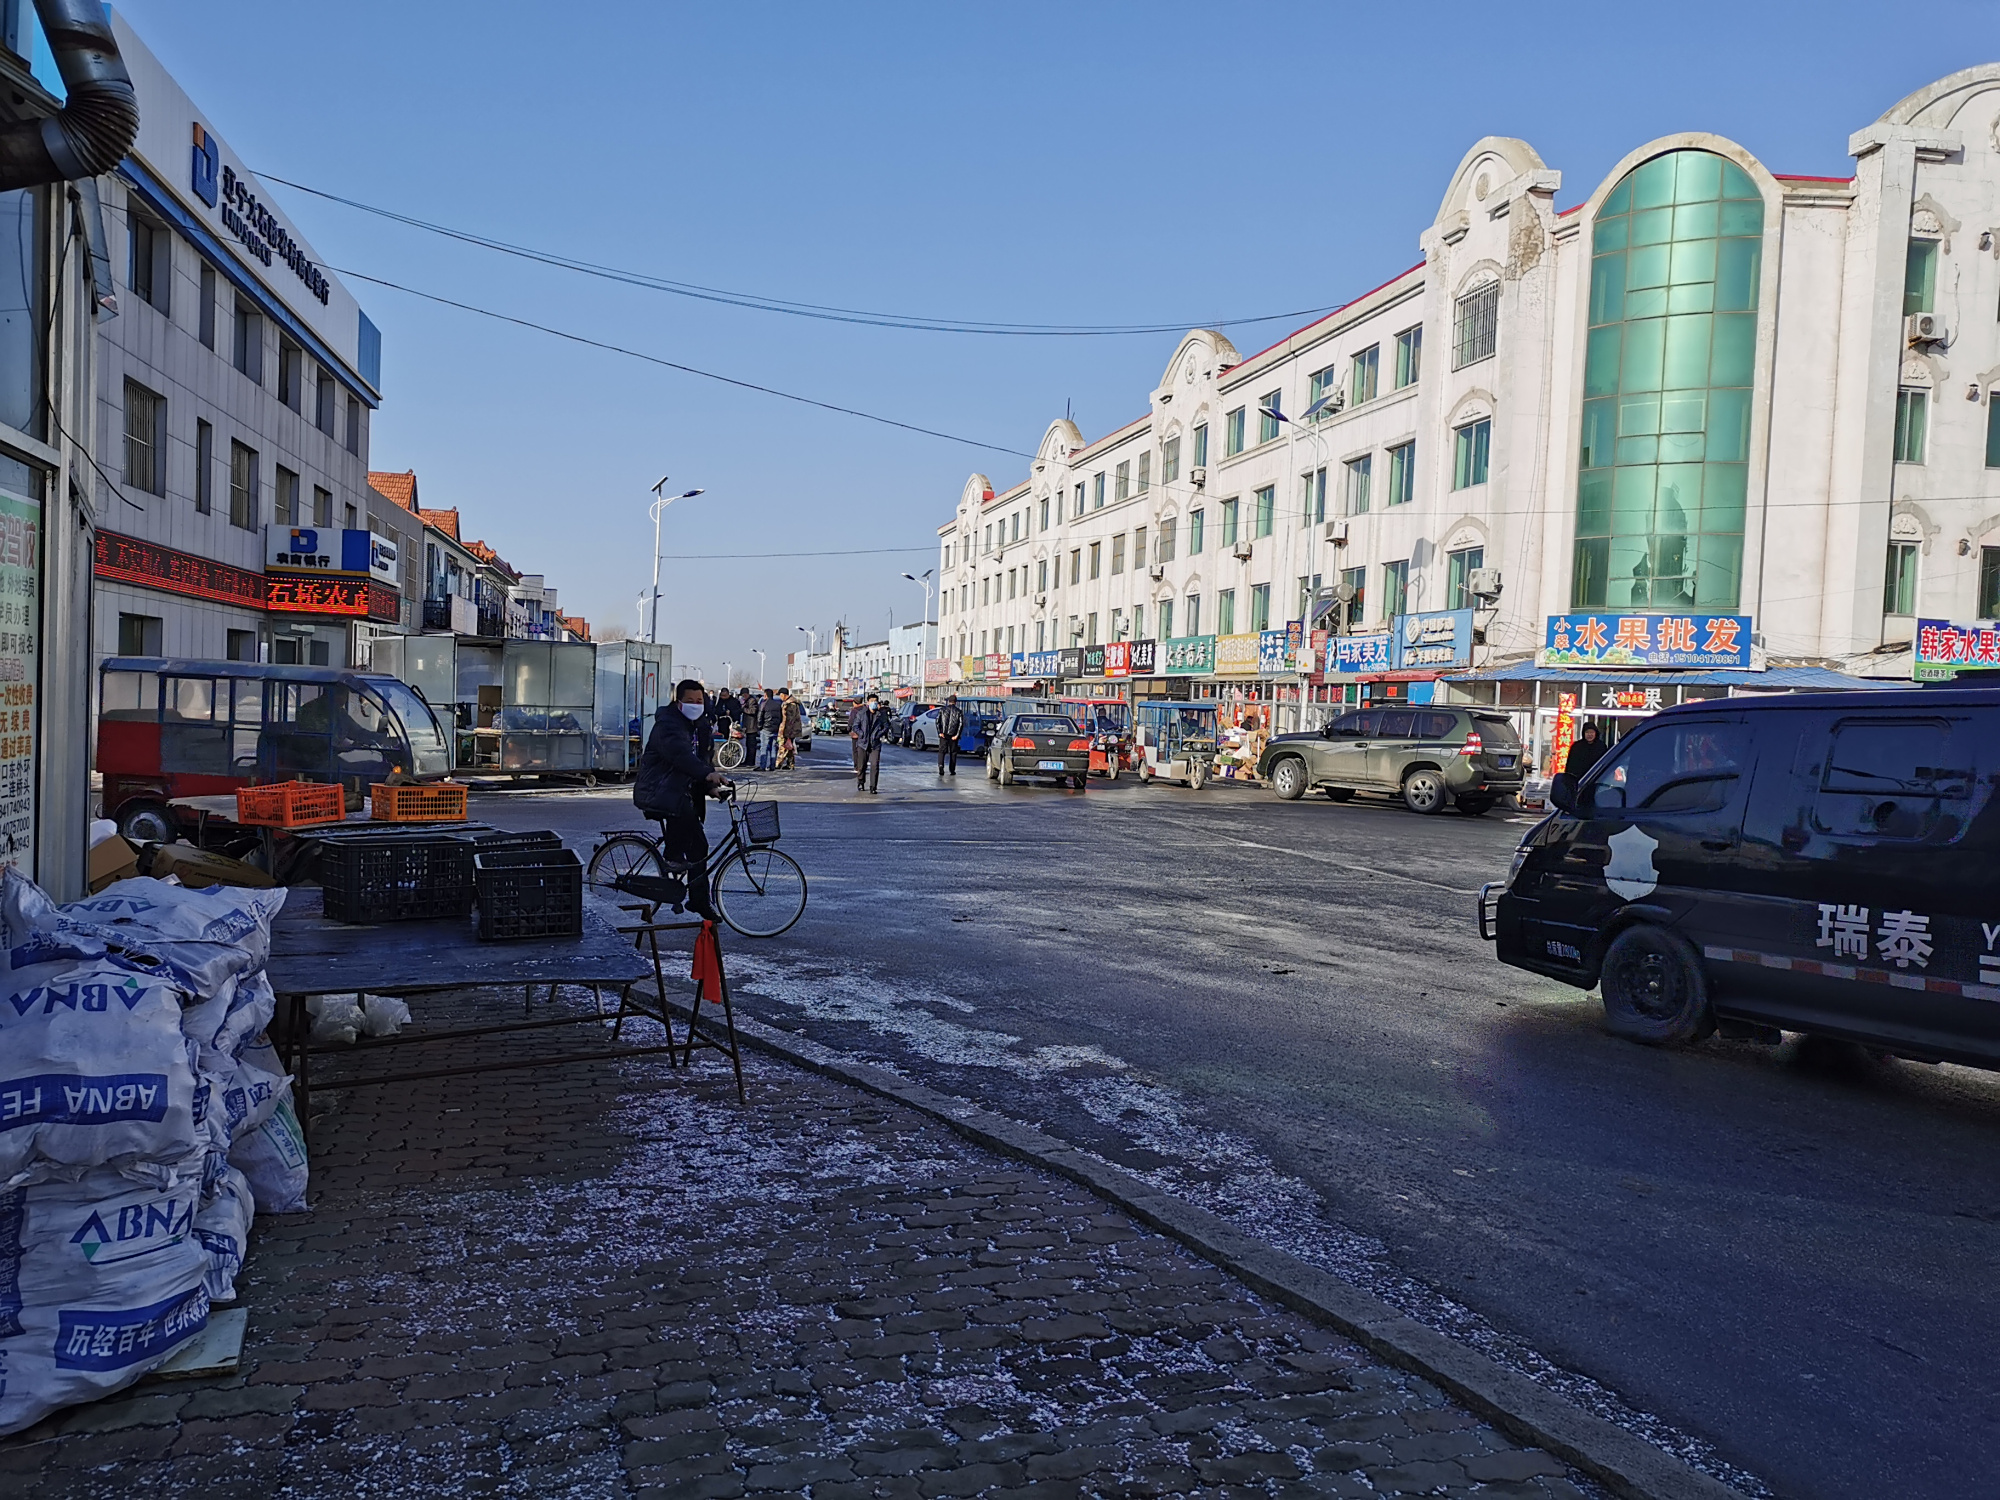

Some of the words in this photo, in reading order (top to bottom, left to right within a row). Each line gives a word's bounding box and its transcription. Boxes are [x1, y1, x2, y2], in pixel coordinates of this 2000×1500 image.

[1339, 638, 1388, 664] 马家美发
[1574, 616, 1742, 653] 水果批发
[1920, 626, 2000, 664] 韩家水果
[1601, 687, 1664, 710] 水果
[1816, 903, 1935, 968] 瑞泰
[9, 983, 149, 1017] ABNA
[63, 1083, 158, 1115] ABNA
[69, 1198, 193, 1244] ABNA
[66, 1318, 159, 1357] 历经百年
